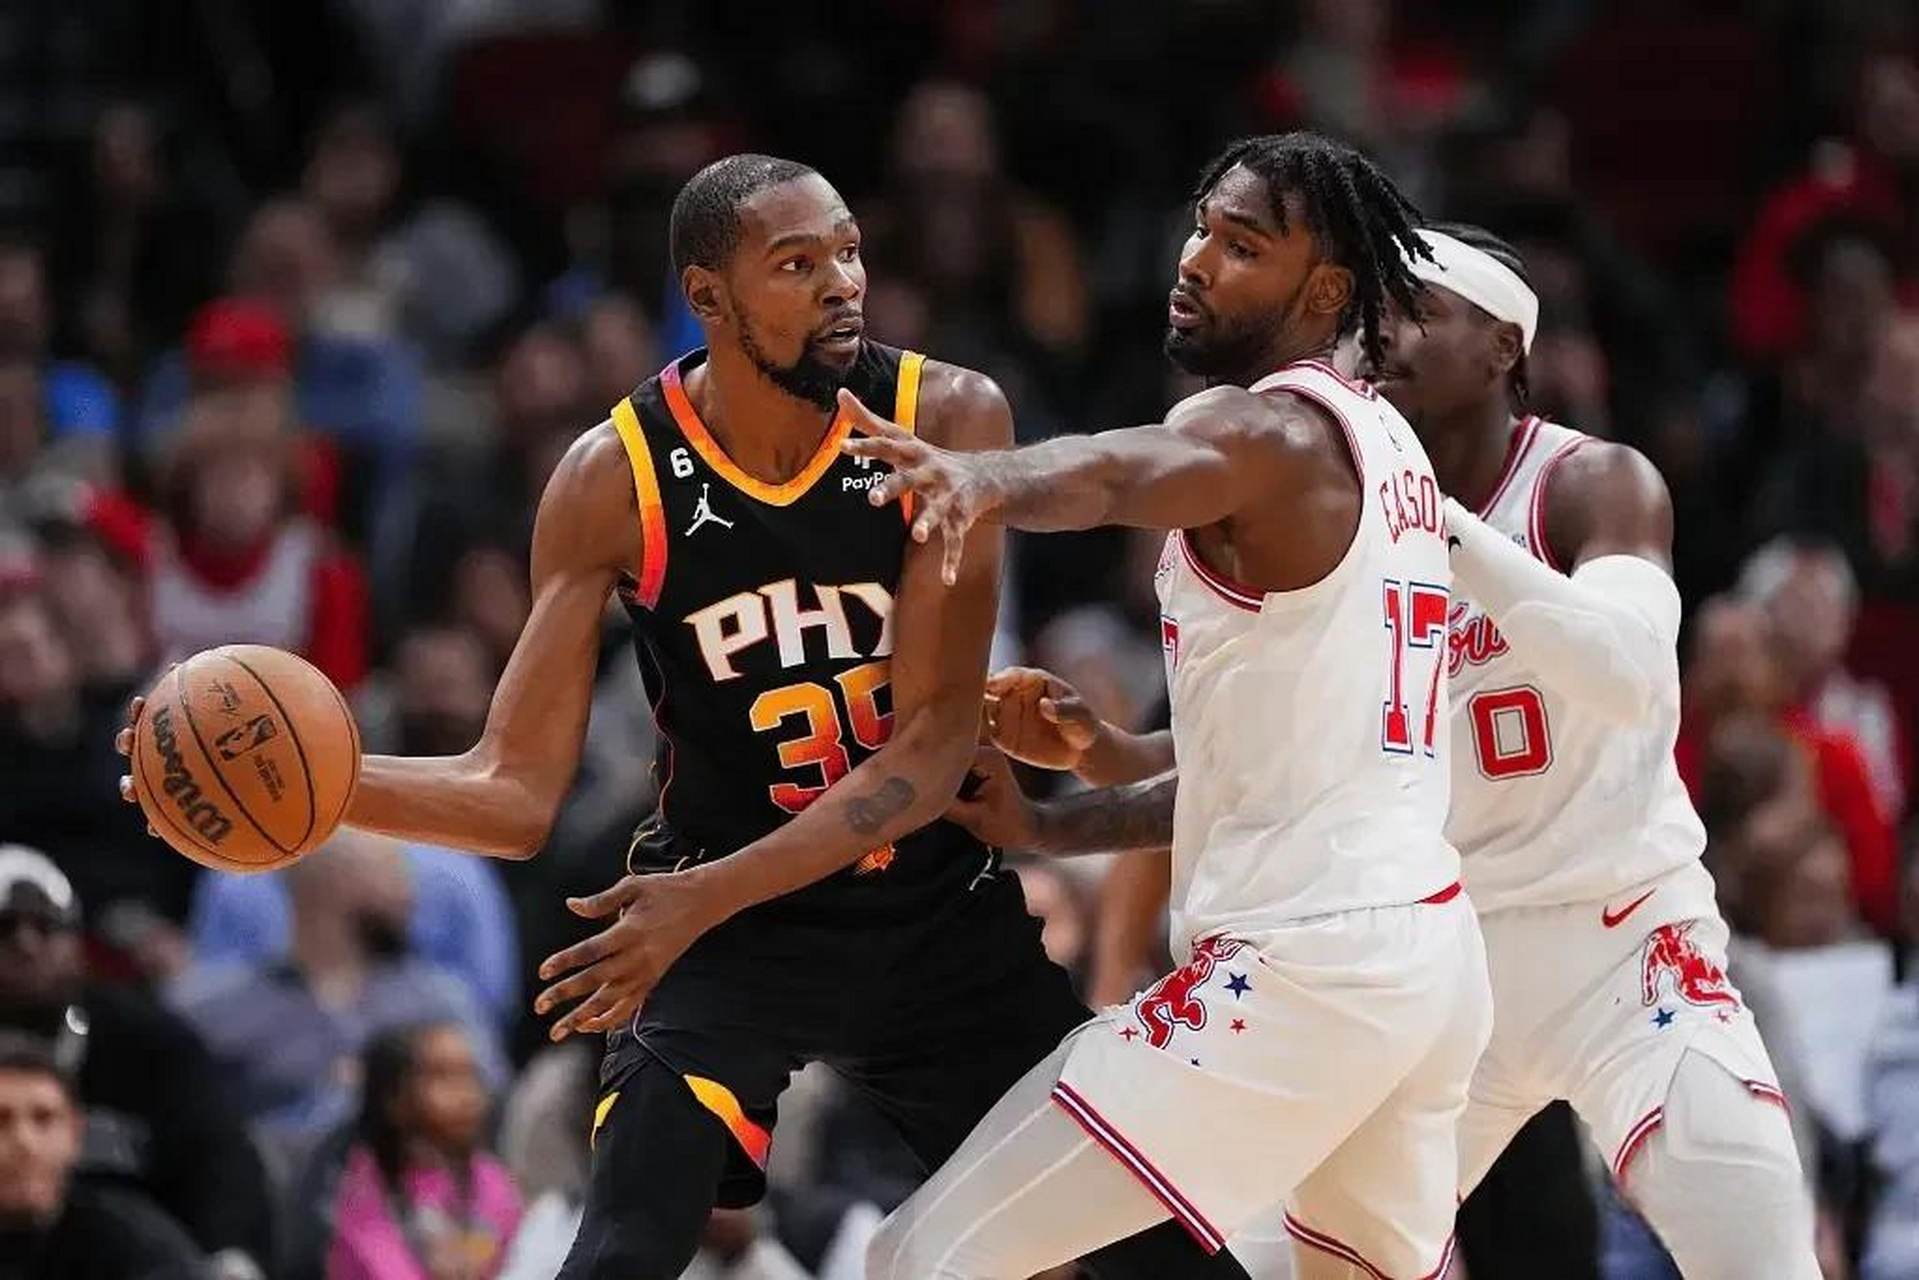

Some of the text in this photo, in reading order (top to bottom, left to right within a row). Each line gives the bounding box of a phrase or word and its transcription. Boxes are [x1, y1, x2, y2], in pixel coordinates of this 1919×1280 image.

[670, 448, 693, 478] 6
[1382, 579, 1449, 758] 17
[1468, 684, 1554, 781] 0
